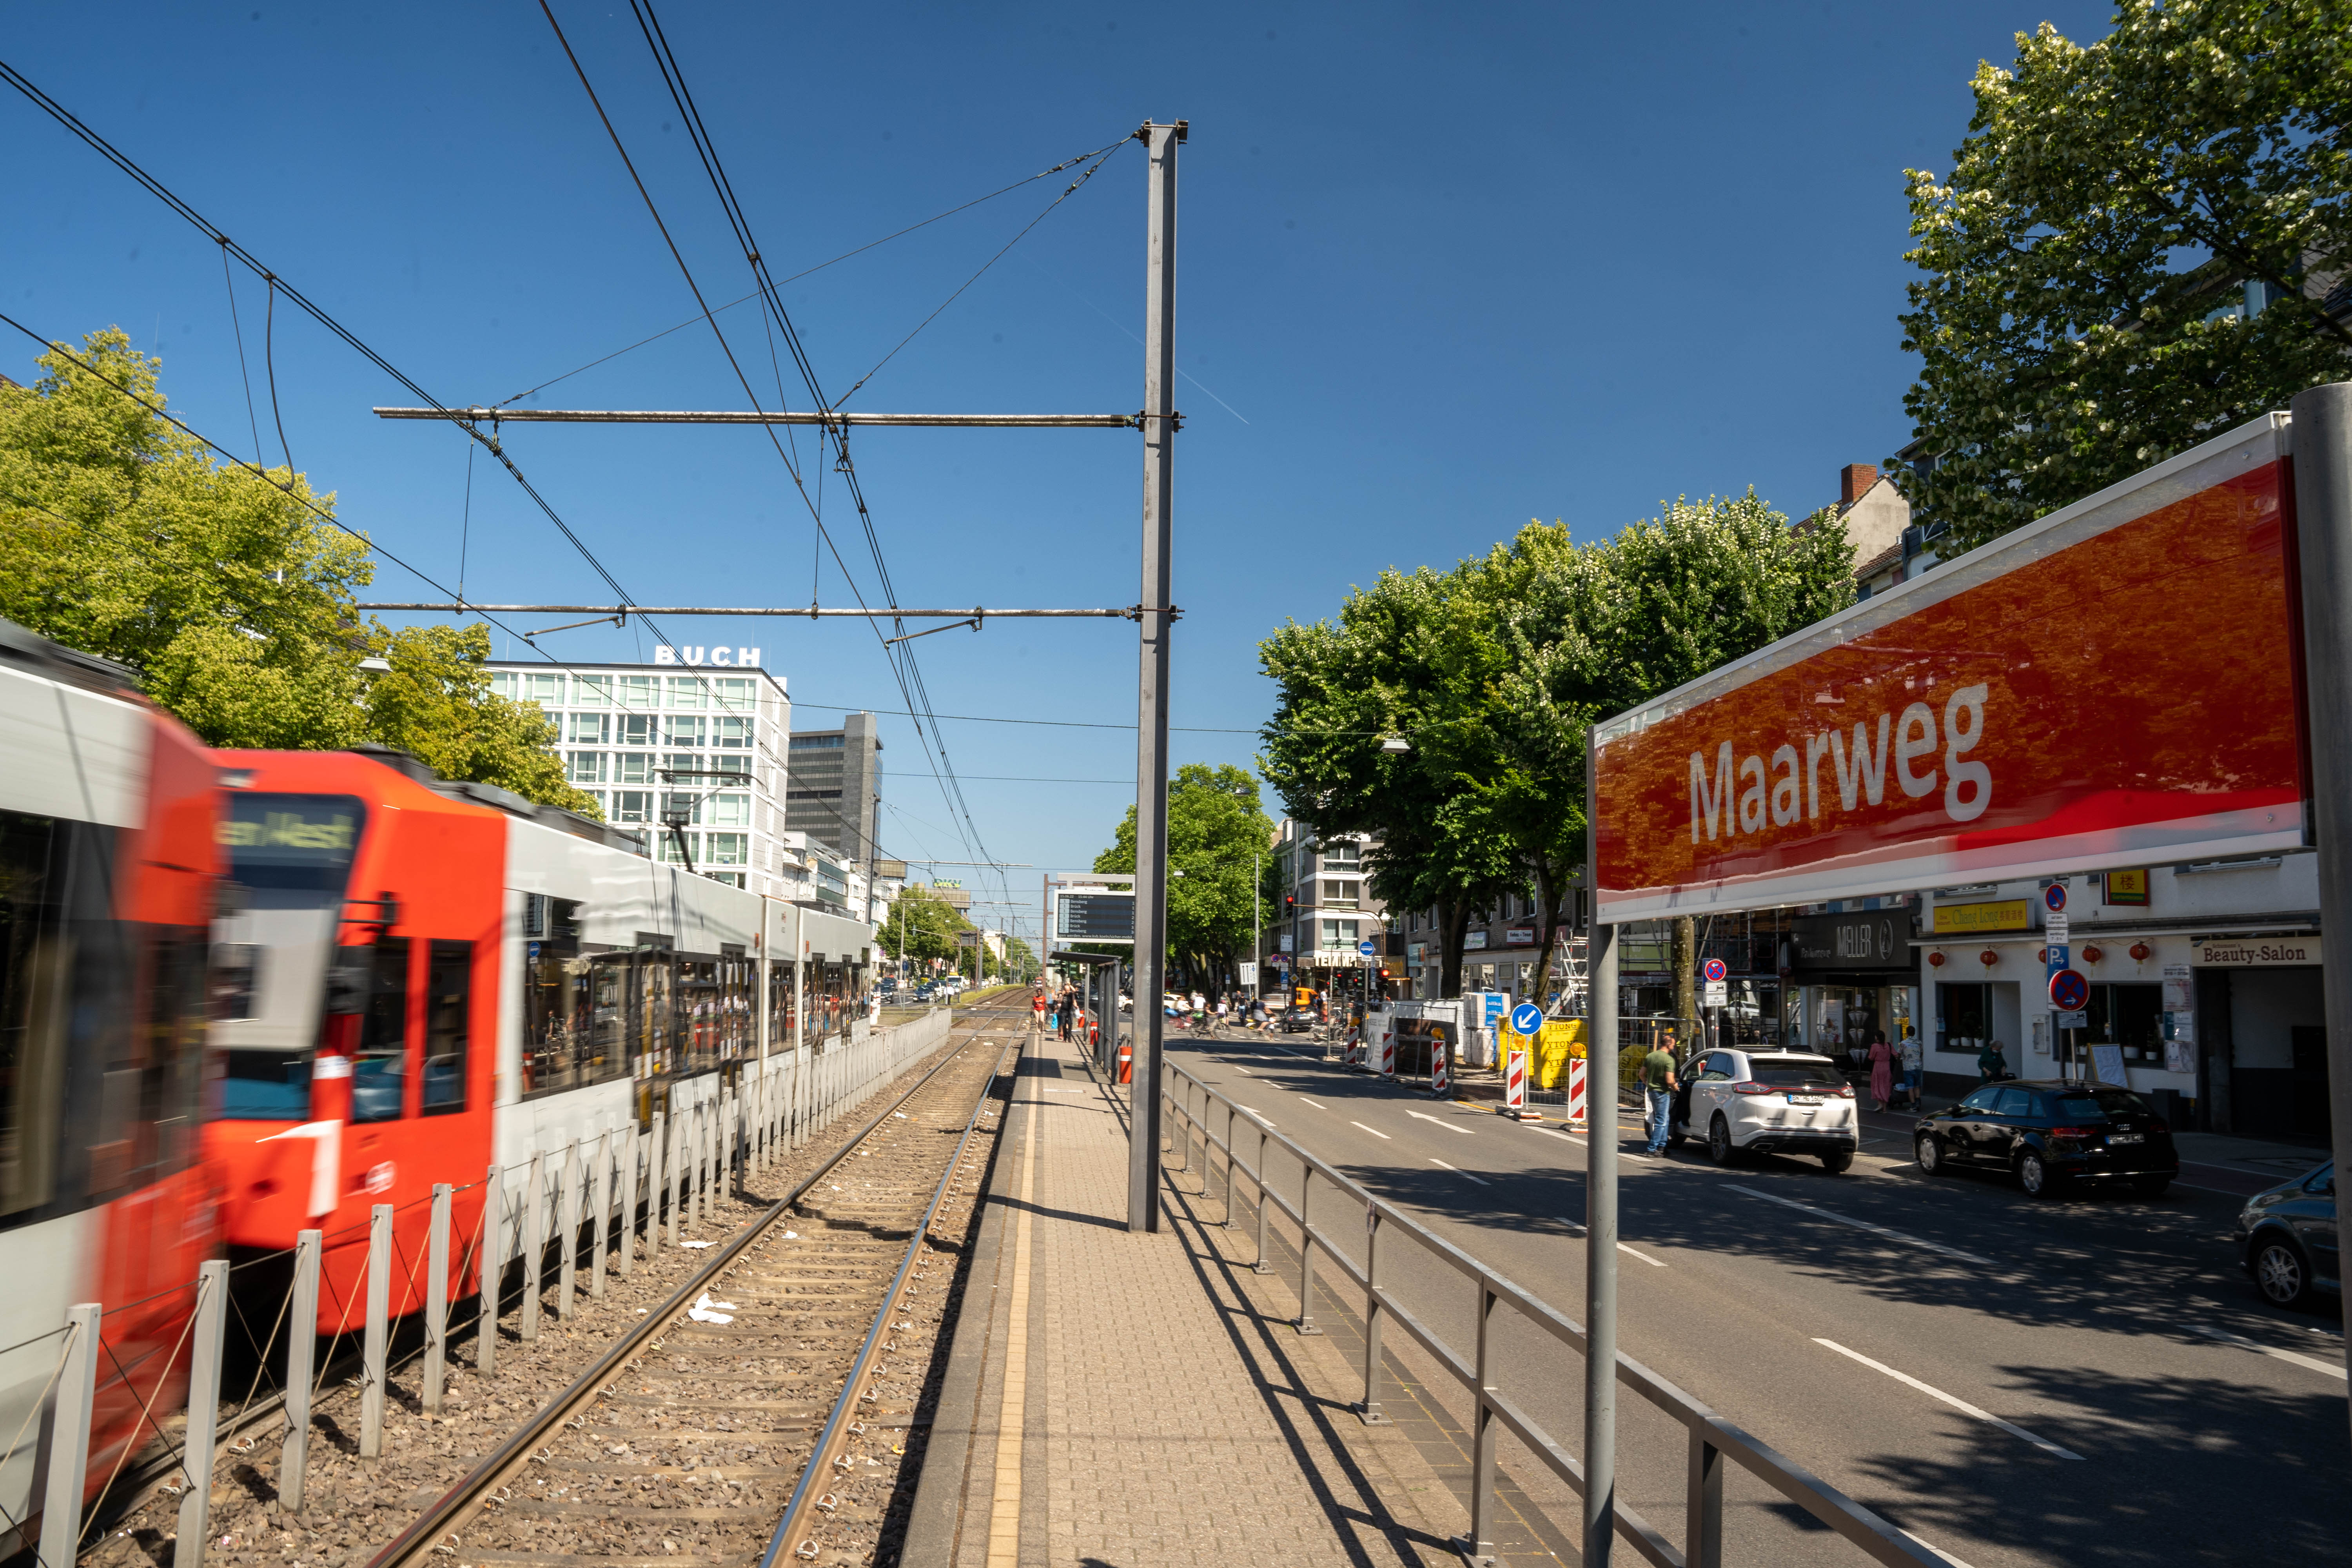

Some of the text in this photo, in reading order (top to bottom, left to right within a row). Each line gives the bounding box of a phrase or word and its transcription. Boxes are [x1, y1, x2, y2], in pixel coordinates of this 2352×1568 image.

[655, 645, 760, 667] BUCH
[1690, 682, 1992, 844] Maarweg
[934, 878, 962, 888] DKV
[1952, 908, 1999, 929] Chang Long
[2050, 948, 2060, 964] P
[2203, 945, 2307, 964] Beauty-Salon
